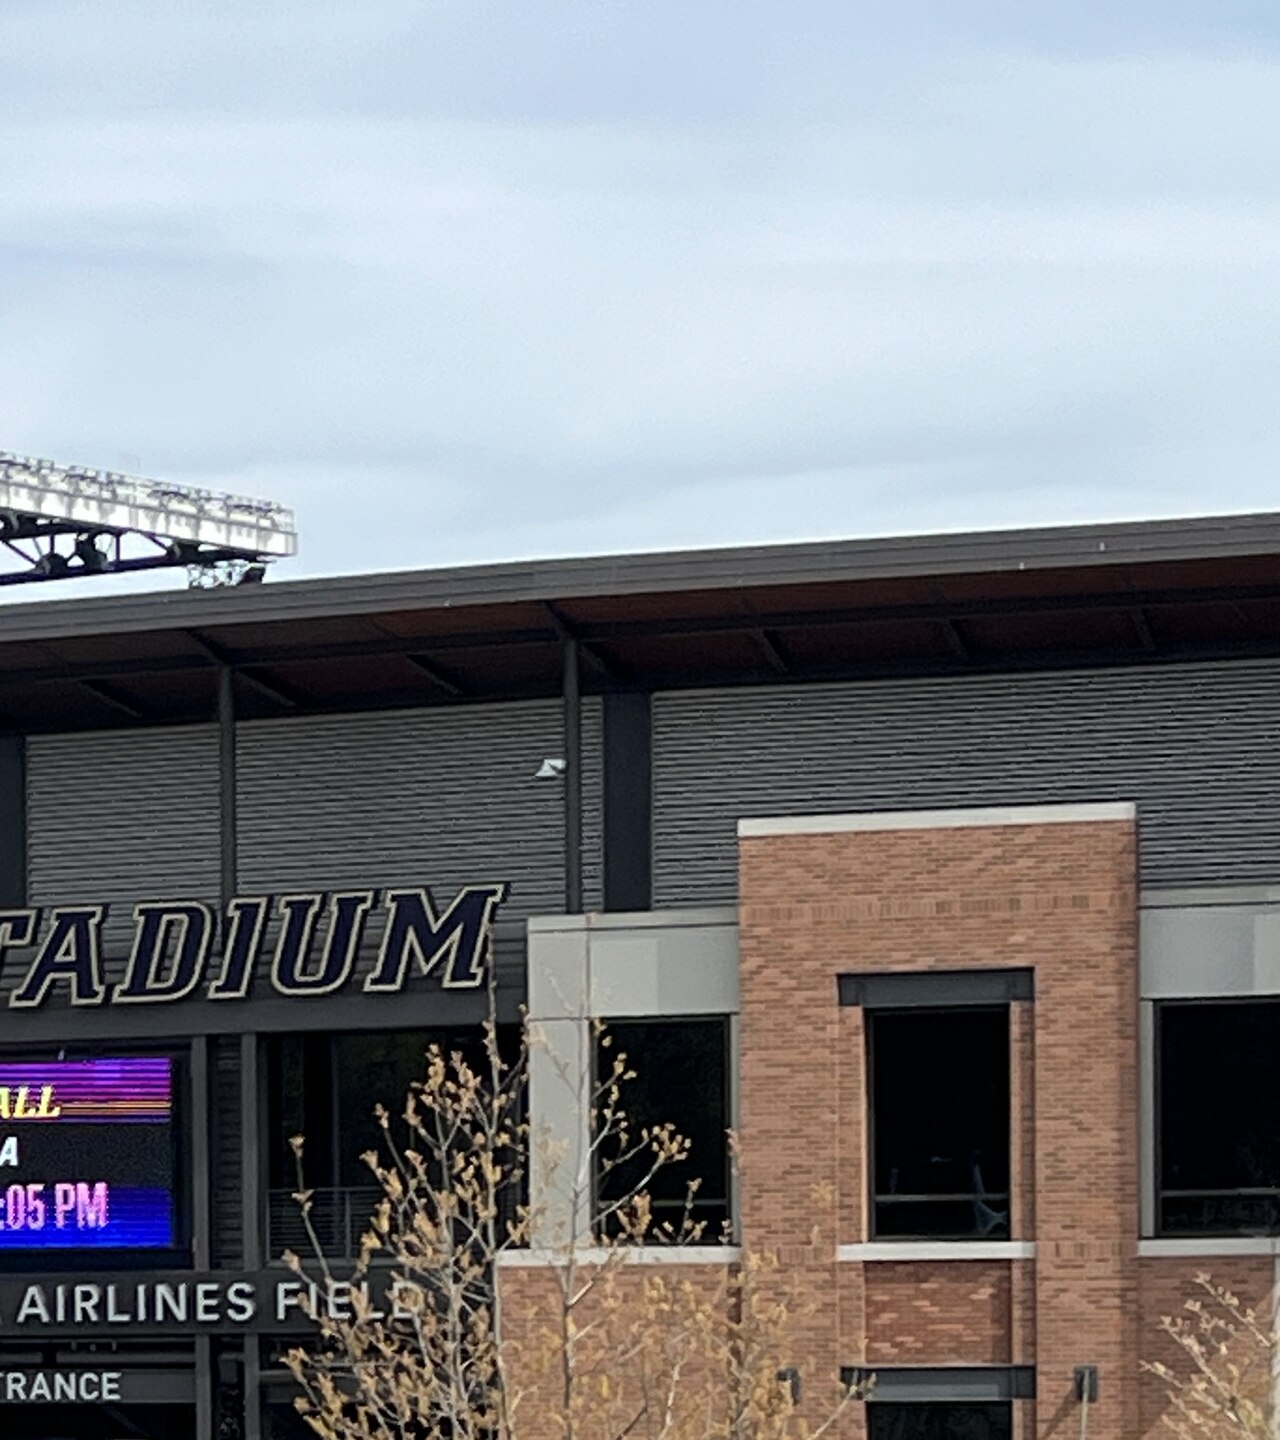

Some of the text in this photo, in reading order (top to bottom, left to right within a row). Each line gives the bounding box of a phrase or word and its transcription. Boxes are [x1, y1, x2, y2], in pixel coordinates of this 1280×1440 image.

[55, 1183, 108, 1229] PM
[17, 1282, 255, 1322] AIRLINES
[276, 1281, 424, 1320] FIELD
